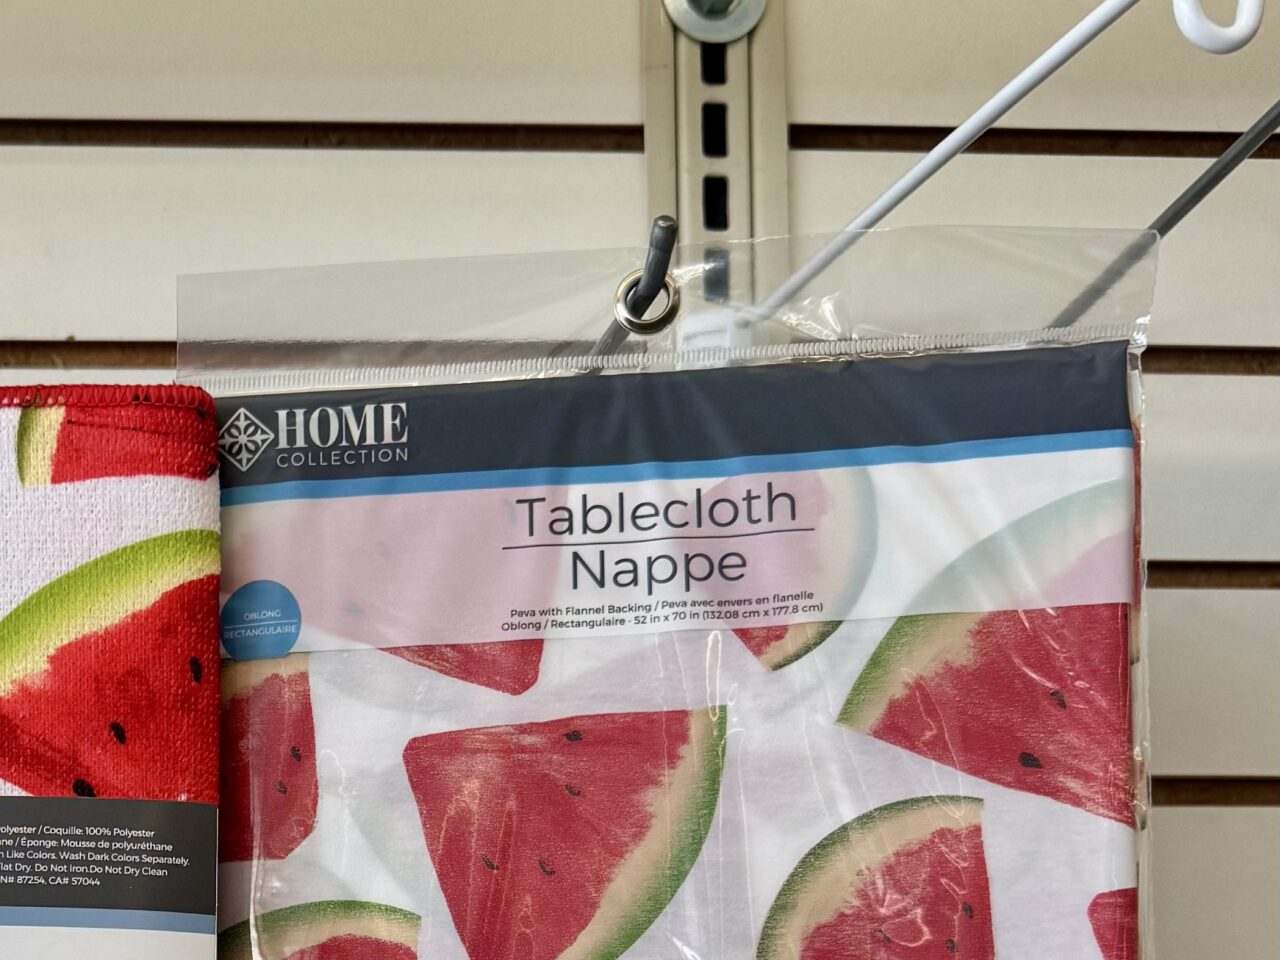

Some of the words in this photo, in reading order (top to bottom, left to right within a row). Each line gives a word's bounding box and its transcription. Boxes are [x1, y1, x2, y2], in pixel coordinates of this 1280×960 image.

[275, 402, 409, 450] HOME
[276, 447, 409, 468] COLLECTION
[515, 482, 797, 538] Tablecloth
[570, 550, 747, 596] Nappe
[510, 609, 536, 618] Peva
[538, 607, 563, 617] with
[565, 605, 605, 616] Flannel
[608, 602, 652, 615] Backing
[661, 600, 687, 610] Peva
[690, 600, 714, 608] avec
[717, 598, 752, 608] envers
[756, 597, 769, 605] en
[773, 590, 814, 602] flanelle
[243, 609, 282, 622] OBLONG
[501, 621, 542, 632] Oblong
[551, 617, 626, 630] Rectangulaire
[634, 616, 647, 625] 52
[650, 614, 661, 624] in
[672, 611, 686, 622] 70
[689, 610, 700, 620] in
[702, 609, 740, 621] (132.08
[742, 609, 760, 618] cm
[763, 608, 770, 617] x
[772, 603, 799, 617] 177.8
[801, 602, 824, 614] cm)
[223, 624, 298, 639] RECTANGULAIRE
[43, 825, 84, 836] Coquille:
[85, 826, 112, 837] 100%
[113, 828, 155, 839] Polyester
[21, 837, 59, 849] Éponge:
[60, 839, 96, 848] Mousse
[97, 840, 110, 849] de
[111, 841, 173, 852] polyuréthane
[6, 849, 25, 859] Like
[59, 851, 86, 861] Wash
[87, 852, 110, 861] Dark
[110, 853, 140, 863] Colors
[141, 854, 190, 867] Separately.
[34, 863, 49, 872] Do
[50, 863, 68, 873] Not
[105, 865, 122, 875] Not
[123, 865, 140, 877] Dry
[141, 866, 168, 877] Clean
[48, 876, 70, 886] CA#
[71, 876, 101, 886] 57044
